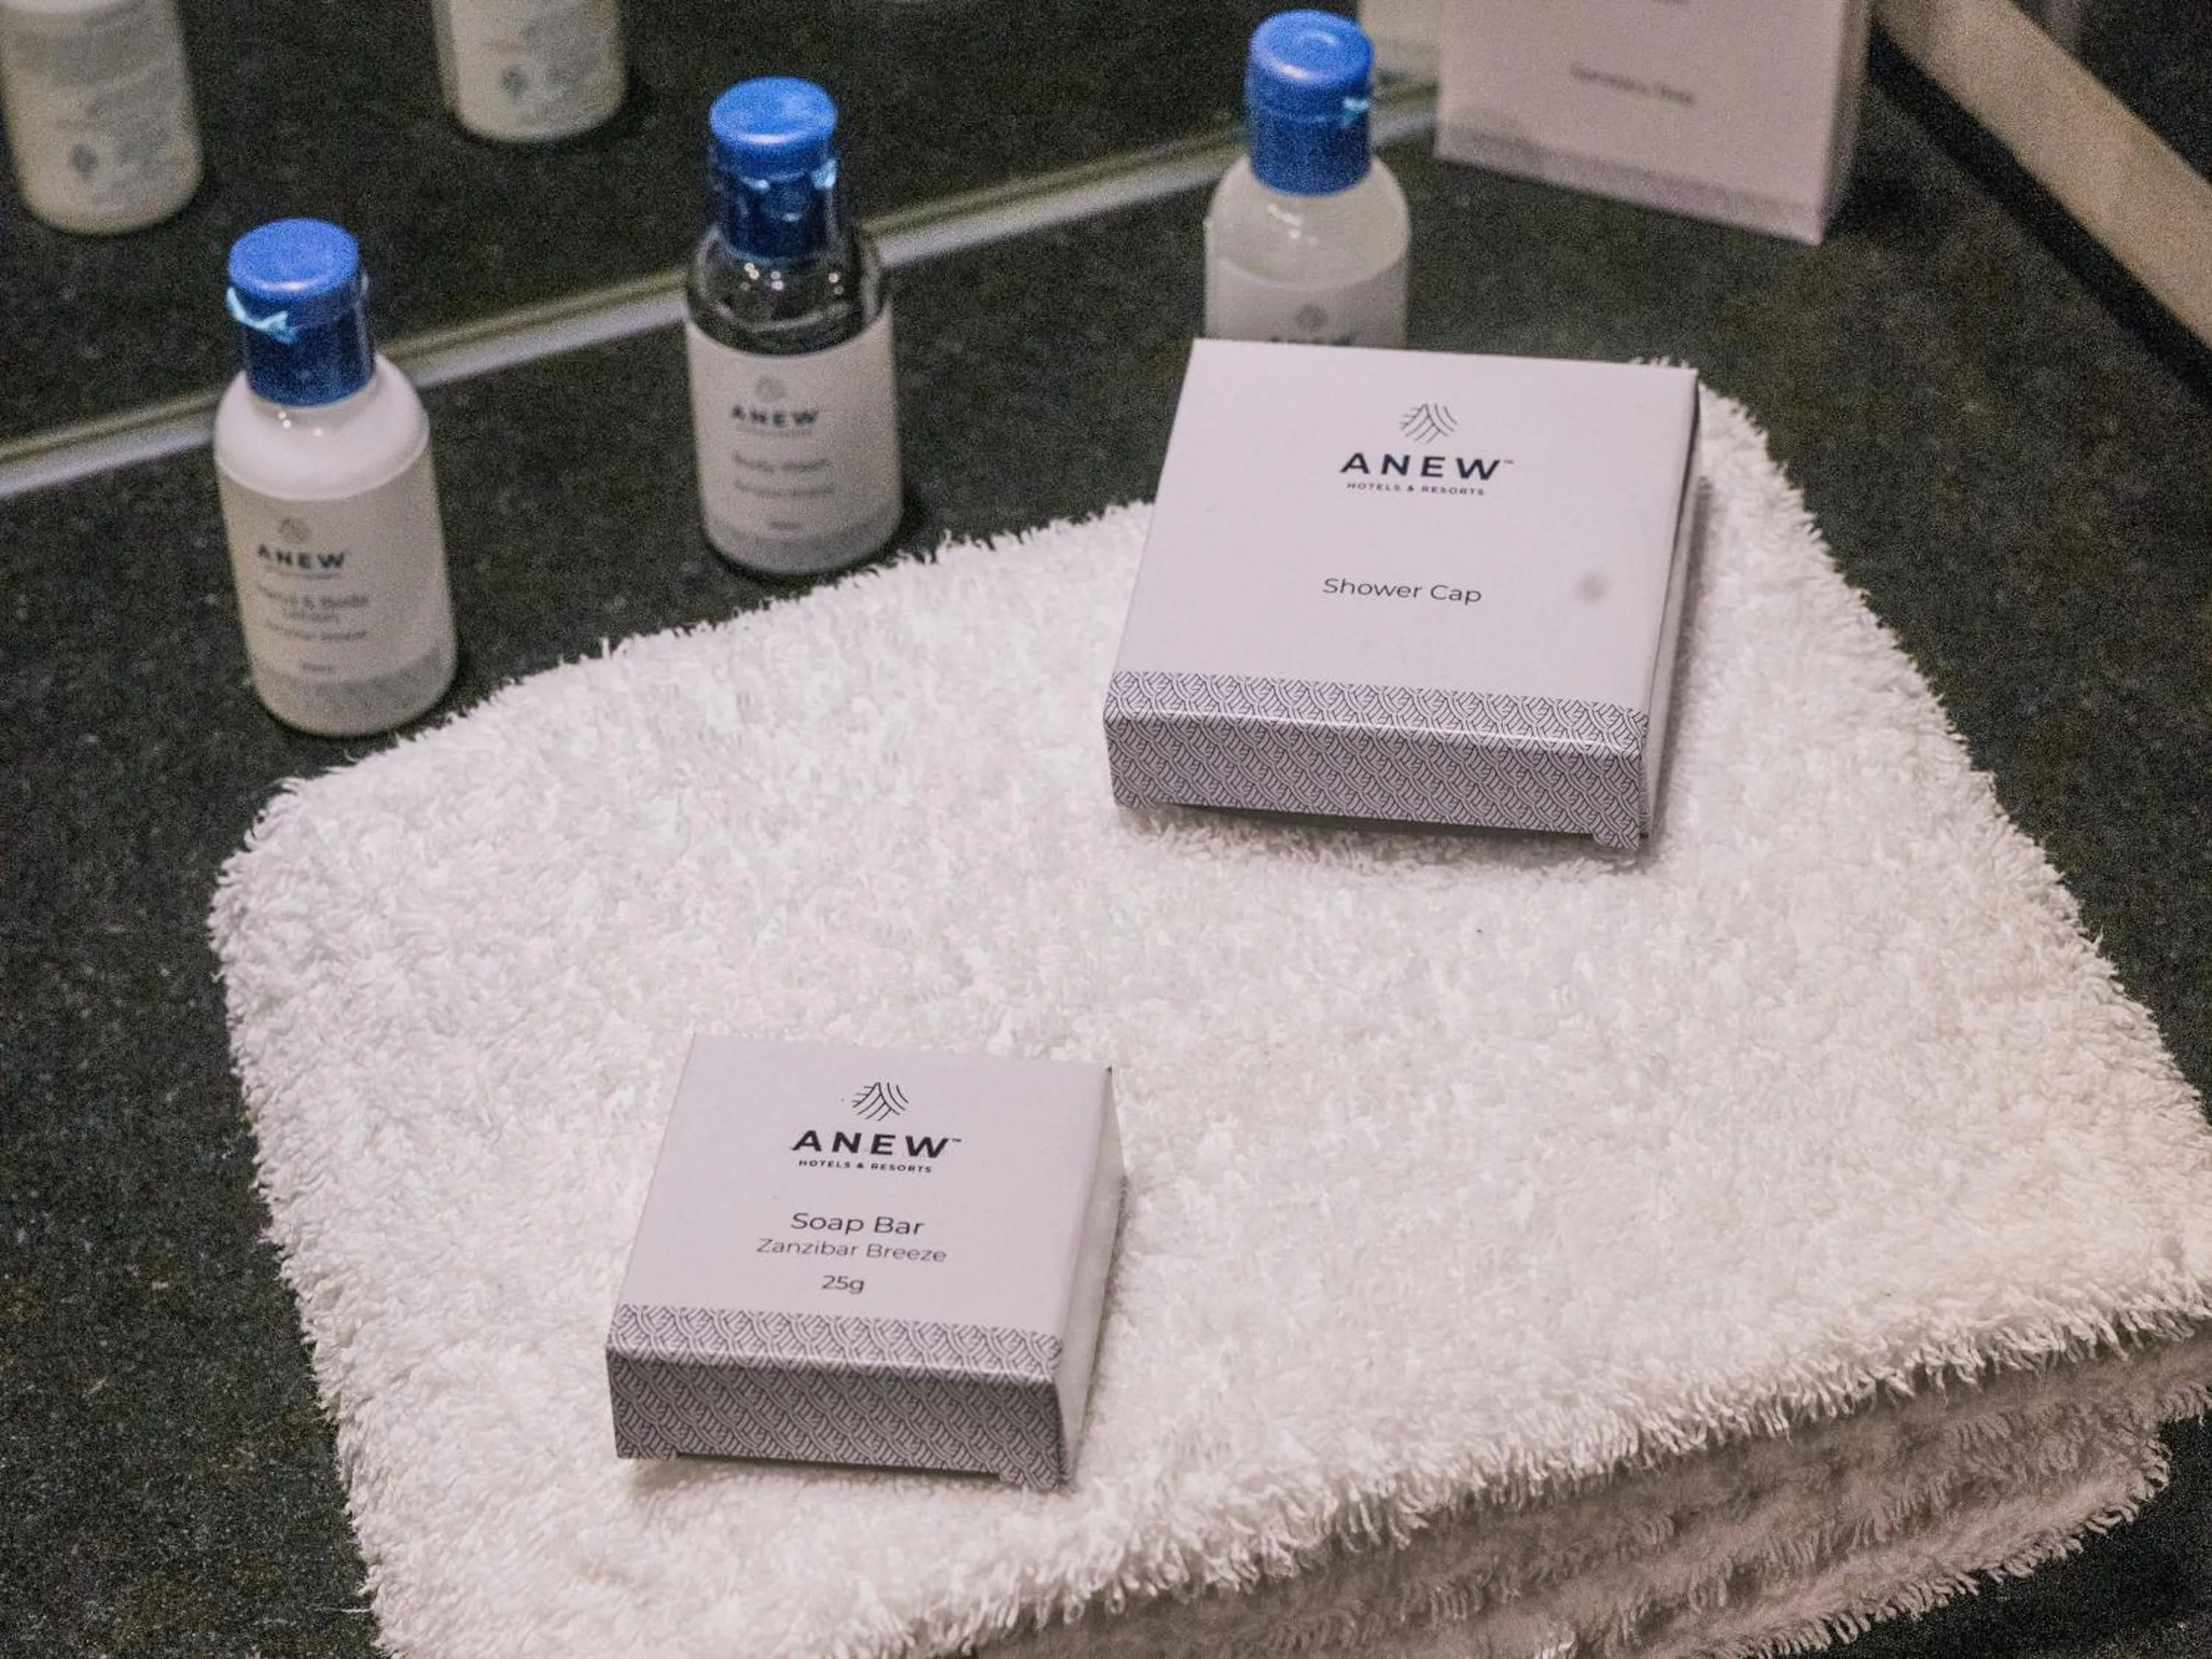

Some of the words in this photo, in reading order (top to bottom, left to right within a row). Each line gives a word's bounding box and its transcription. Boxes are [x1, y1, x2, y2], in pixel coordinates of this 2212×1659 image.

[731, 404, 820, 426] ANEW
[1346, 482, 1402, 492] HOTELS
[1406, 484, 1416, 493] &
[1421, 485, 1486, 495] RESORTS
[257, 543, 347, 569] ANEW
[1322, 577, 1423, 599] Shower
[1429, 583, 1482, 606] Cap
[798, 1159, 851, 1169] HOTELS
[870, 1163, 933, 1174] RESORTS
[790, 1212, 864, 1235] Soap
[873, 1217, 926, 1236] Bar
[756, 1238, 860, 1256] Zanzibar
[866, 1243, 948, 1262] Breeze
[821, 1275, 866, 1295] 25g
